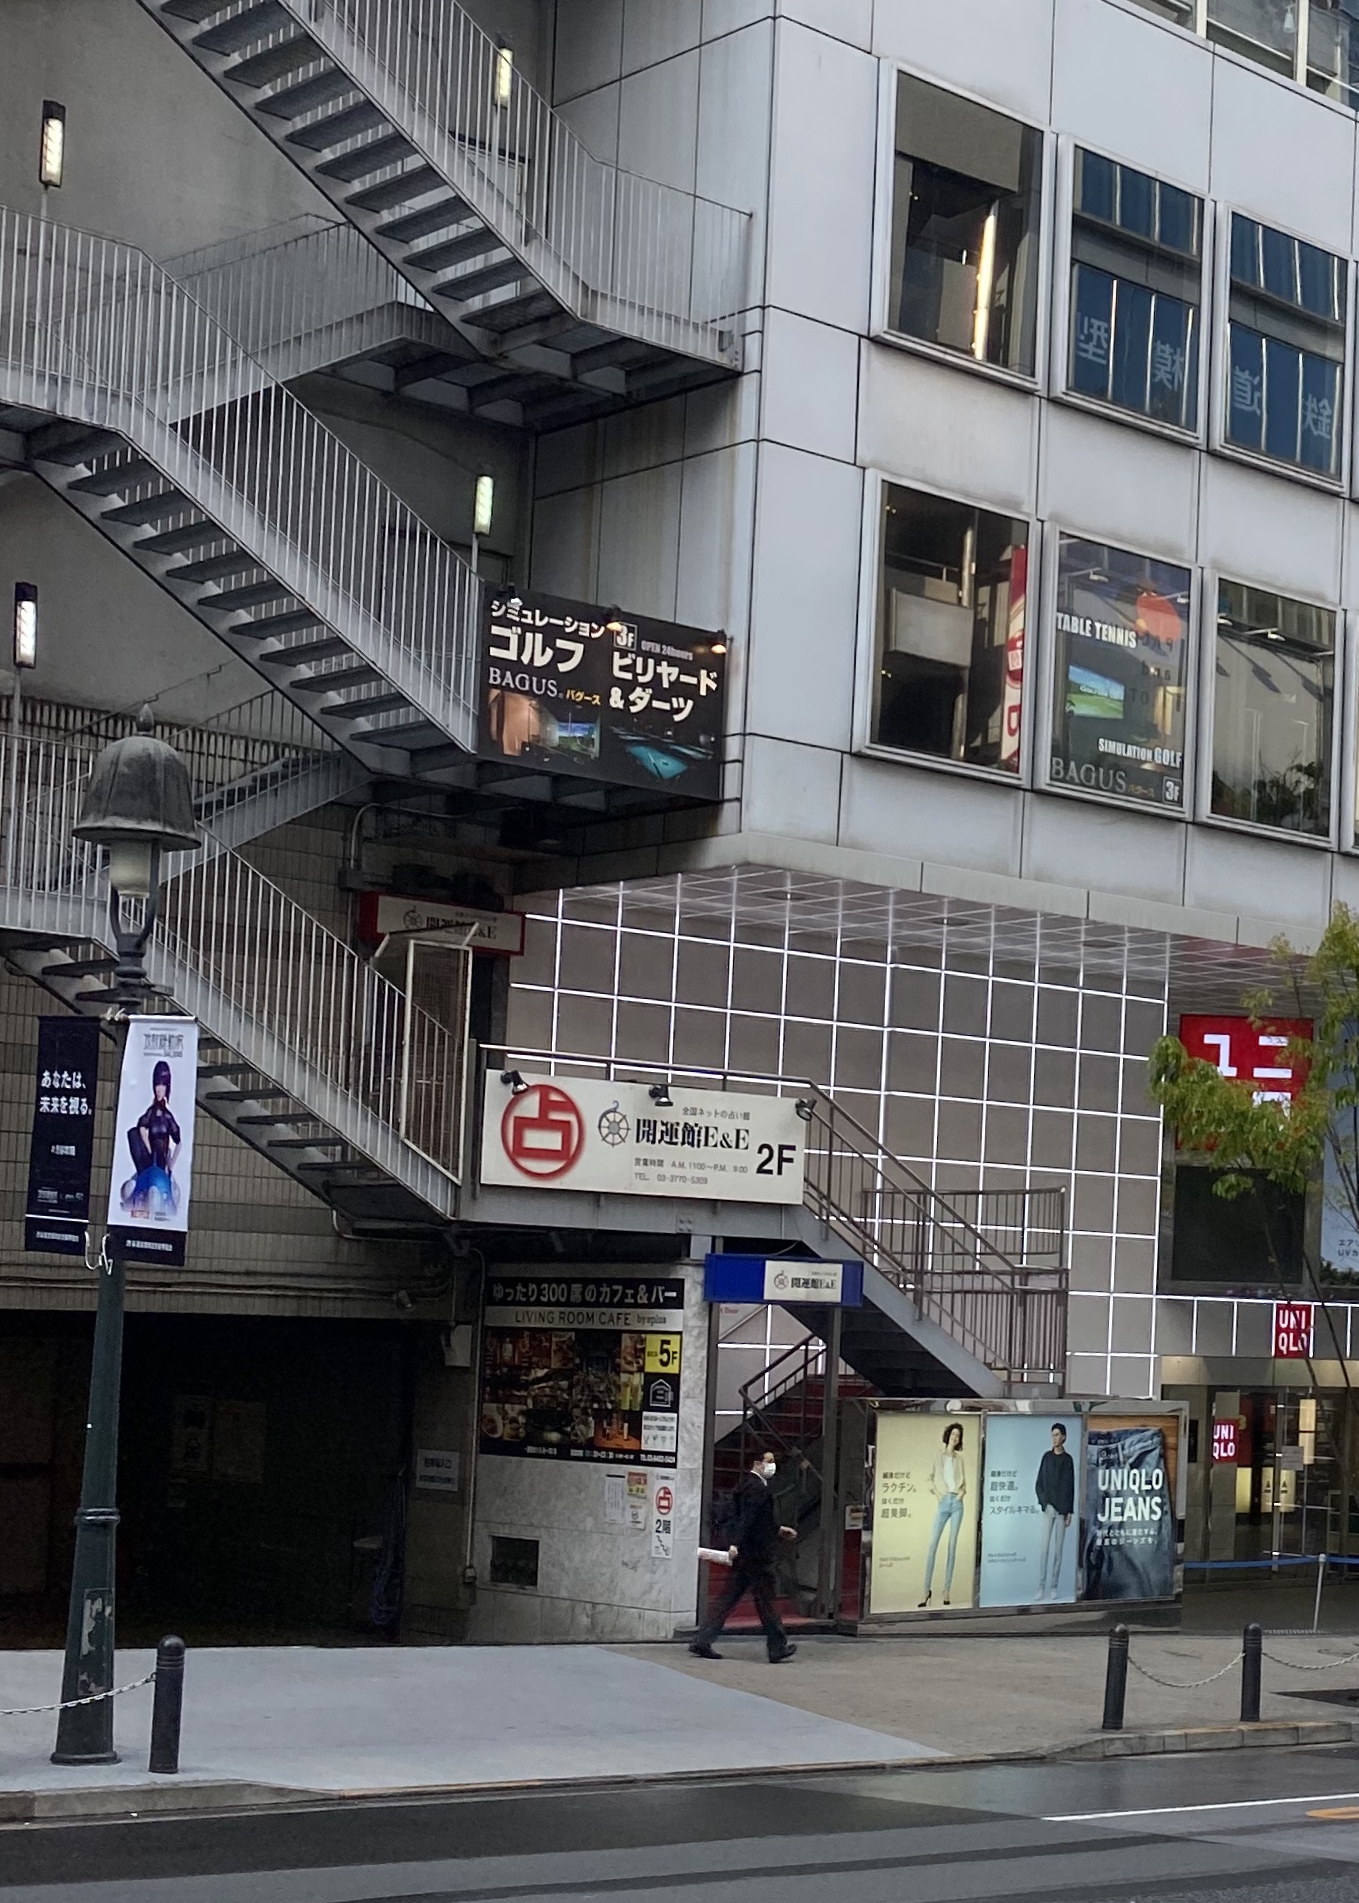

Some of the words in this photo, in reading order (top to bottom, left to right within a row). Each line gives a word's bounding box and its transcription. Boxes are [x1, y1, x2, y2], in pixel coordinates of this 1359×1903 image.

[489, 599, 606, 639] シミュレーション
[1056, 611, 1093, 638] TABLE
[1094, 620, 1138, 649] TENNIS
[616, 624, 635, 647] 3F
[640, 639, 661, 653] OPEN
[488, 625, 585, 673] ゴルフ
[488, 666, 559, 698] BAGUS
[611, 650, 718, 697] ビリヤード
[565, 688, 602, 706] バグース
[1098, 737, 1153, 763] SIMULATION
[1153, 746, 1183, 769] GOLF
[1051, 755, 1127, 794] BAGUS
[1165, 780, 1180, 802] 3F
[41, 1069, 87, 1090] あなたは、
[39, 1095, 93, 1116] 未来を視る。
[635, 1117, 750, 1150] 開運館E&E
[755, 1142, 797, 1176] 2F
[514, 1310, 555, 1324] LIVING
[558, 1311, 595, 1326] ROOM
[598, 1311, 632, 1327] CAFE
[1278, 1309, 1306, 1330] UNI
[658, 1338, 678, 1368] 5F
[1278, 1332, 1308, 1355] QLO
[1213, 1424, 1235, 1440] UNI
[1212, 1442, 1236, 1460] QLO
[1097, 1468, 1164, 1495] UNIQLO
[1096, 1496, 1163, 1522] JEANS
[655, 1518, 672, 1535] 2階
